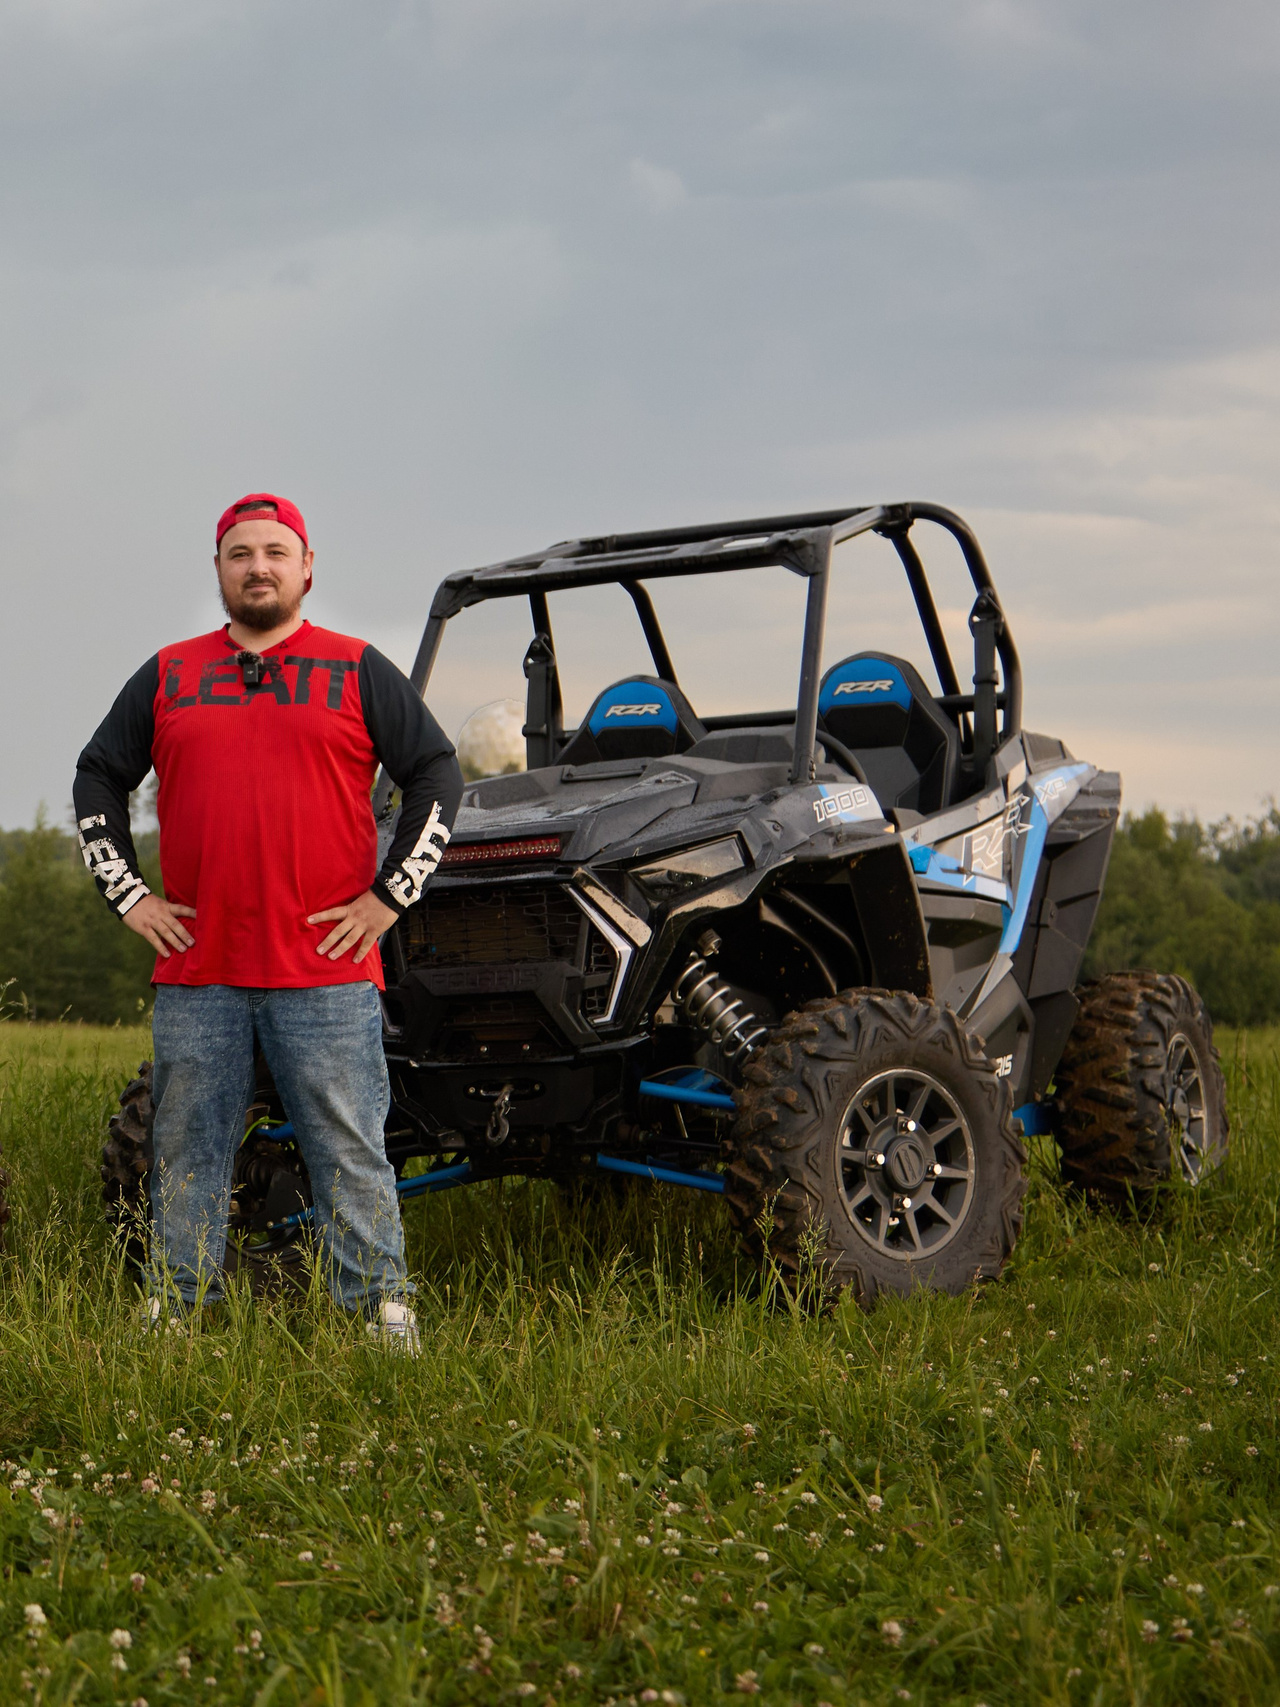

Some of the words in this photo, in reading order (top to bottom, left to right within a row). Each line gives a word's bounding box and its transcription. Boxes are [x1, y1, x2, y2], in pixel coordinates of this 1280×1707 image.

[165, 655, 359, 712] LEATT
[833, 679, 895, 696] RZR
[604, 703, 662, 718] RZR
[813, 786, 869, 823] 1000
[1034, 776, 1068, 807] XP
[384, 801, 451, 907] EATT
